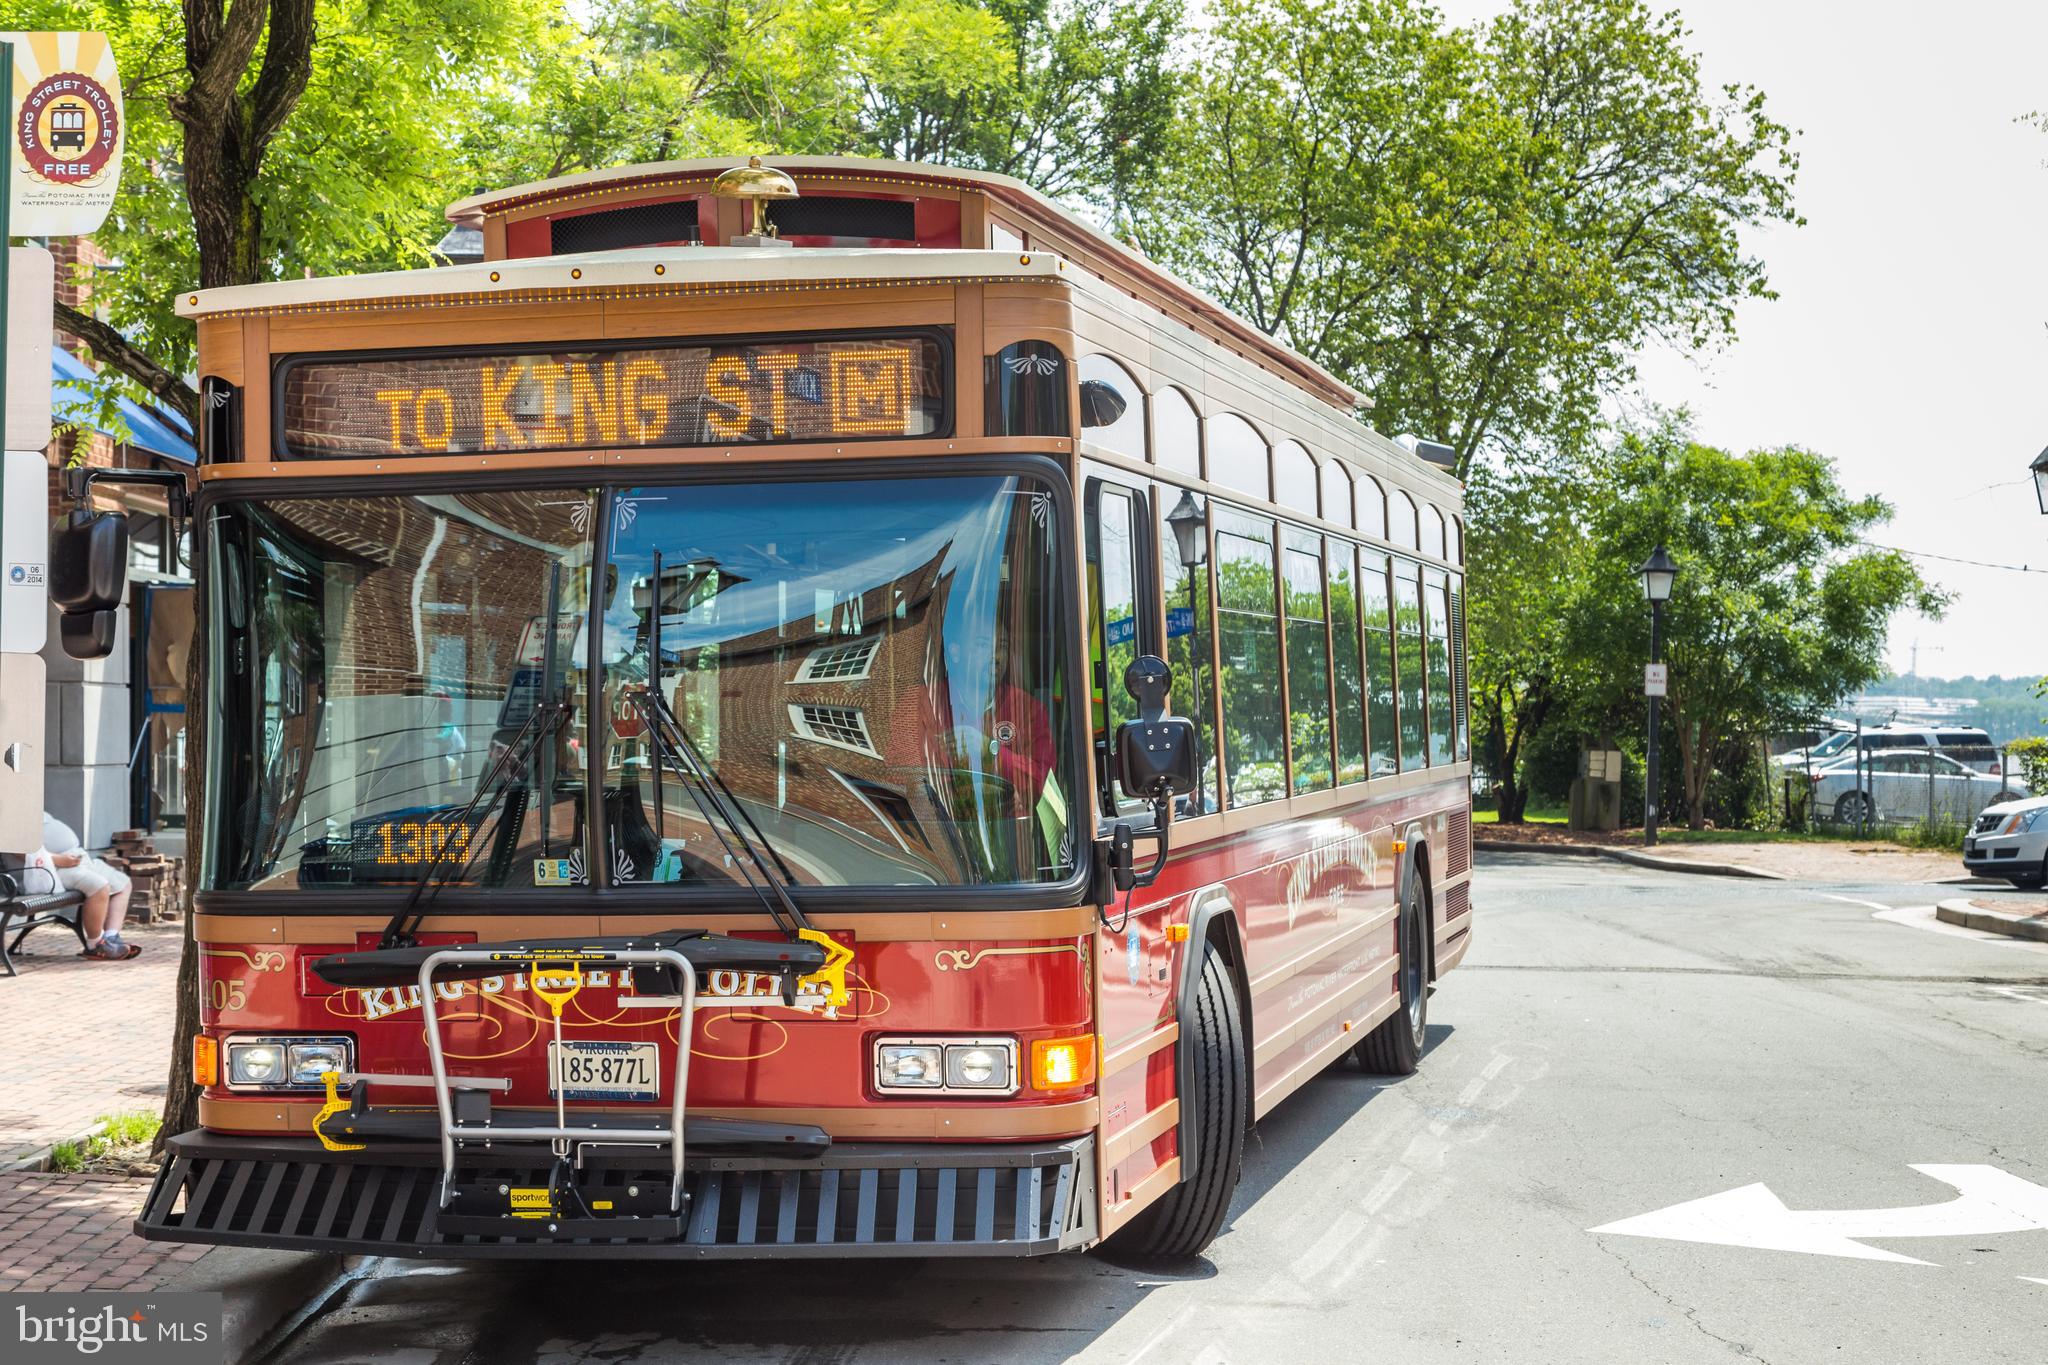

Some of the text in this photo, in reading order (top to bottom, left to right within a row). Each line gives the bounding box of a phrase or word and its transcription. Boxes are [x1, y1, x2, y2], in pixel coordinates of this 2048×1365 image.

[24, 80, 112, 150] KING STREET TROLLEY
[44, 163, 91, 175] FREE
[376, 388, 453, 450] TO
[481, 359, 669, 446] KING
[707, 353, 799, 437] ST
[377, 822, 470, 864] 1303
[538, 862, 546, 879] 6
[361, 982, 465, 1020] KING
[561, 1057, 651, 1084] 185-877L
[511, 1194, 550, 1202] sportwor
